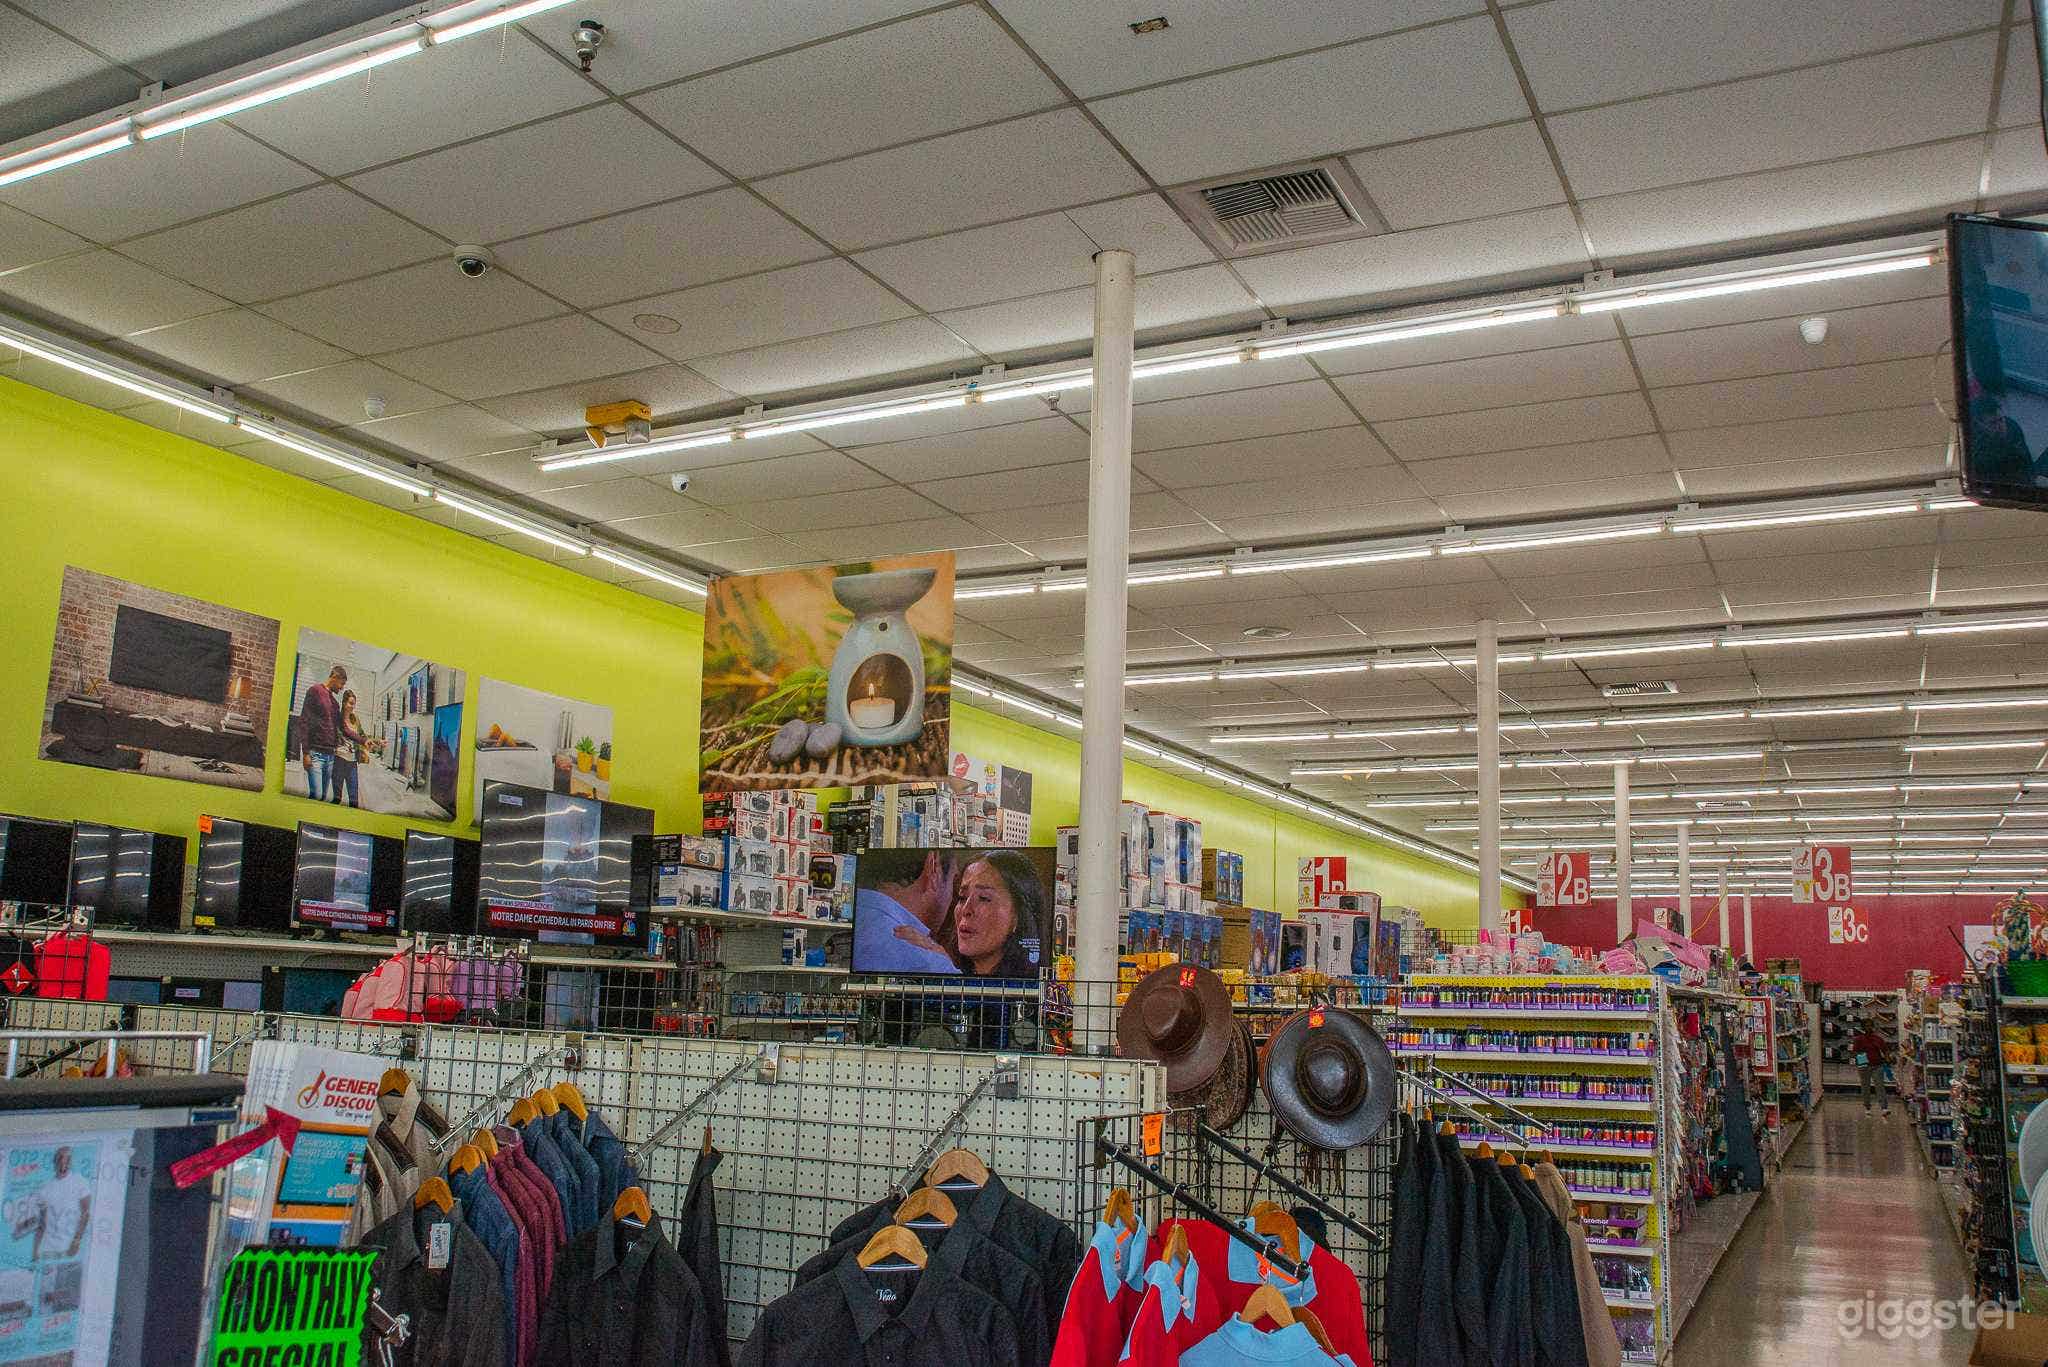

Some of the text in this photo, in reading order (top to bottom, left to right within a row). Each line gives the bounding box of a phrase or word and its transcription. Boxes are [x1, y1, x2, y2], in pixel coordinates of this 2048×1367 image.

[1557, 854, 1589, 905] 2B
[1814, 848, 1851, 902] 3B
[491, 911, 616, 930] NOTRE DAME CATHEDRAL IN PARIS ON FIRE
[1843, 907, 1868, 943] 3C
[323, 1095, 375, 1111] DISCOU
[325, 1077, 378, 1096] GENER
[220, 1259, 368, 1334] MONTHLY
